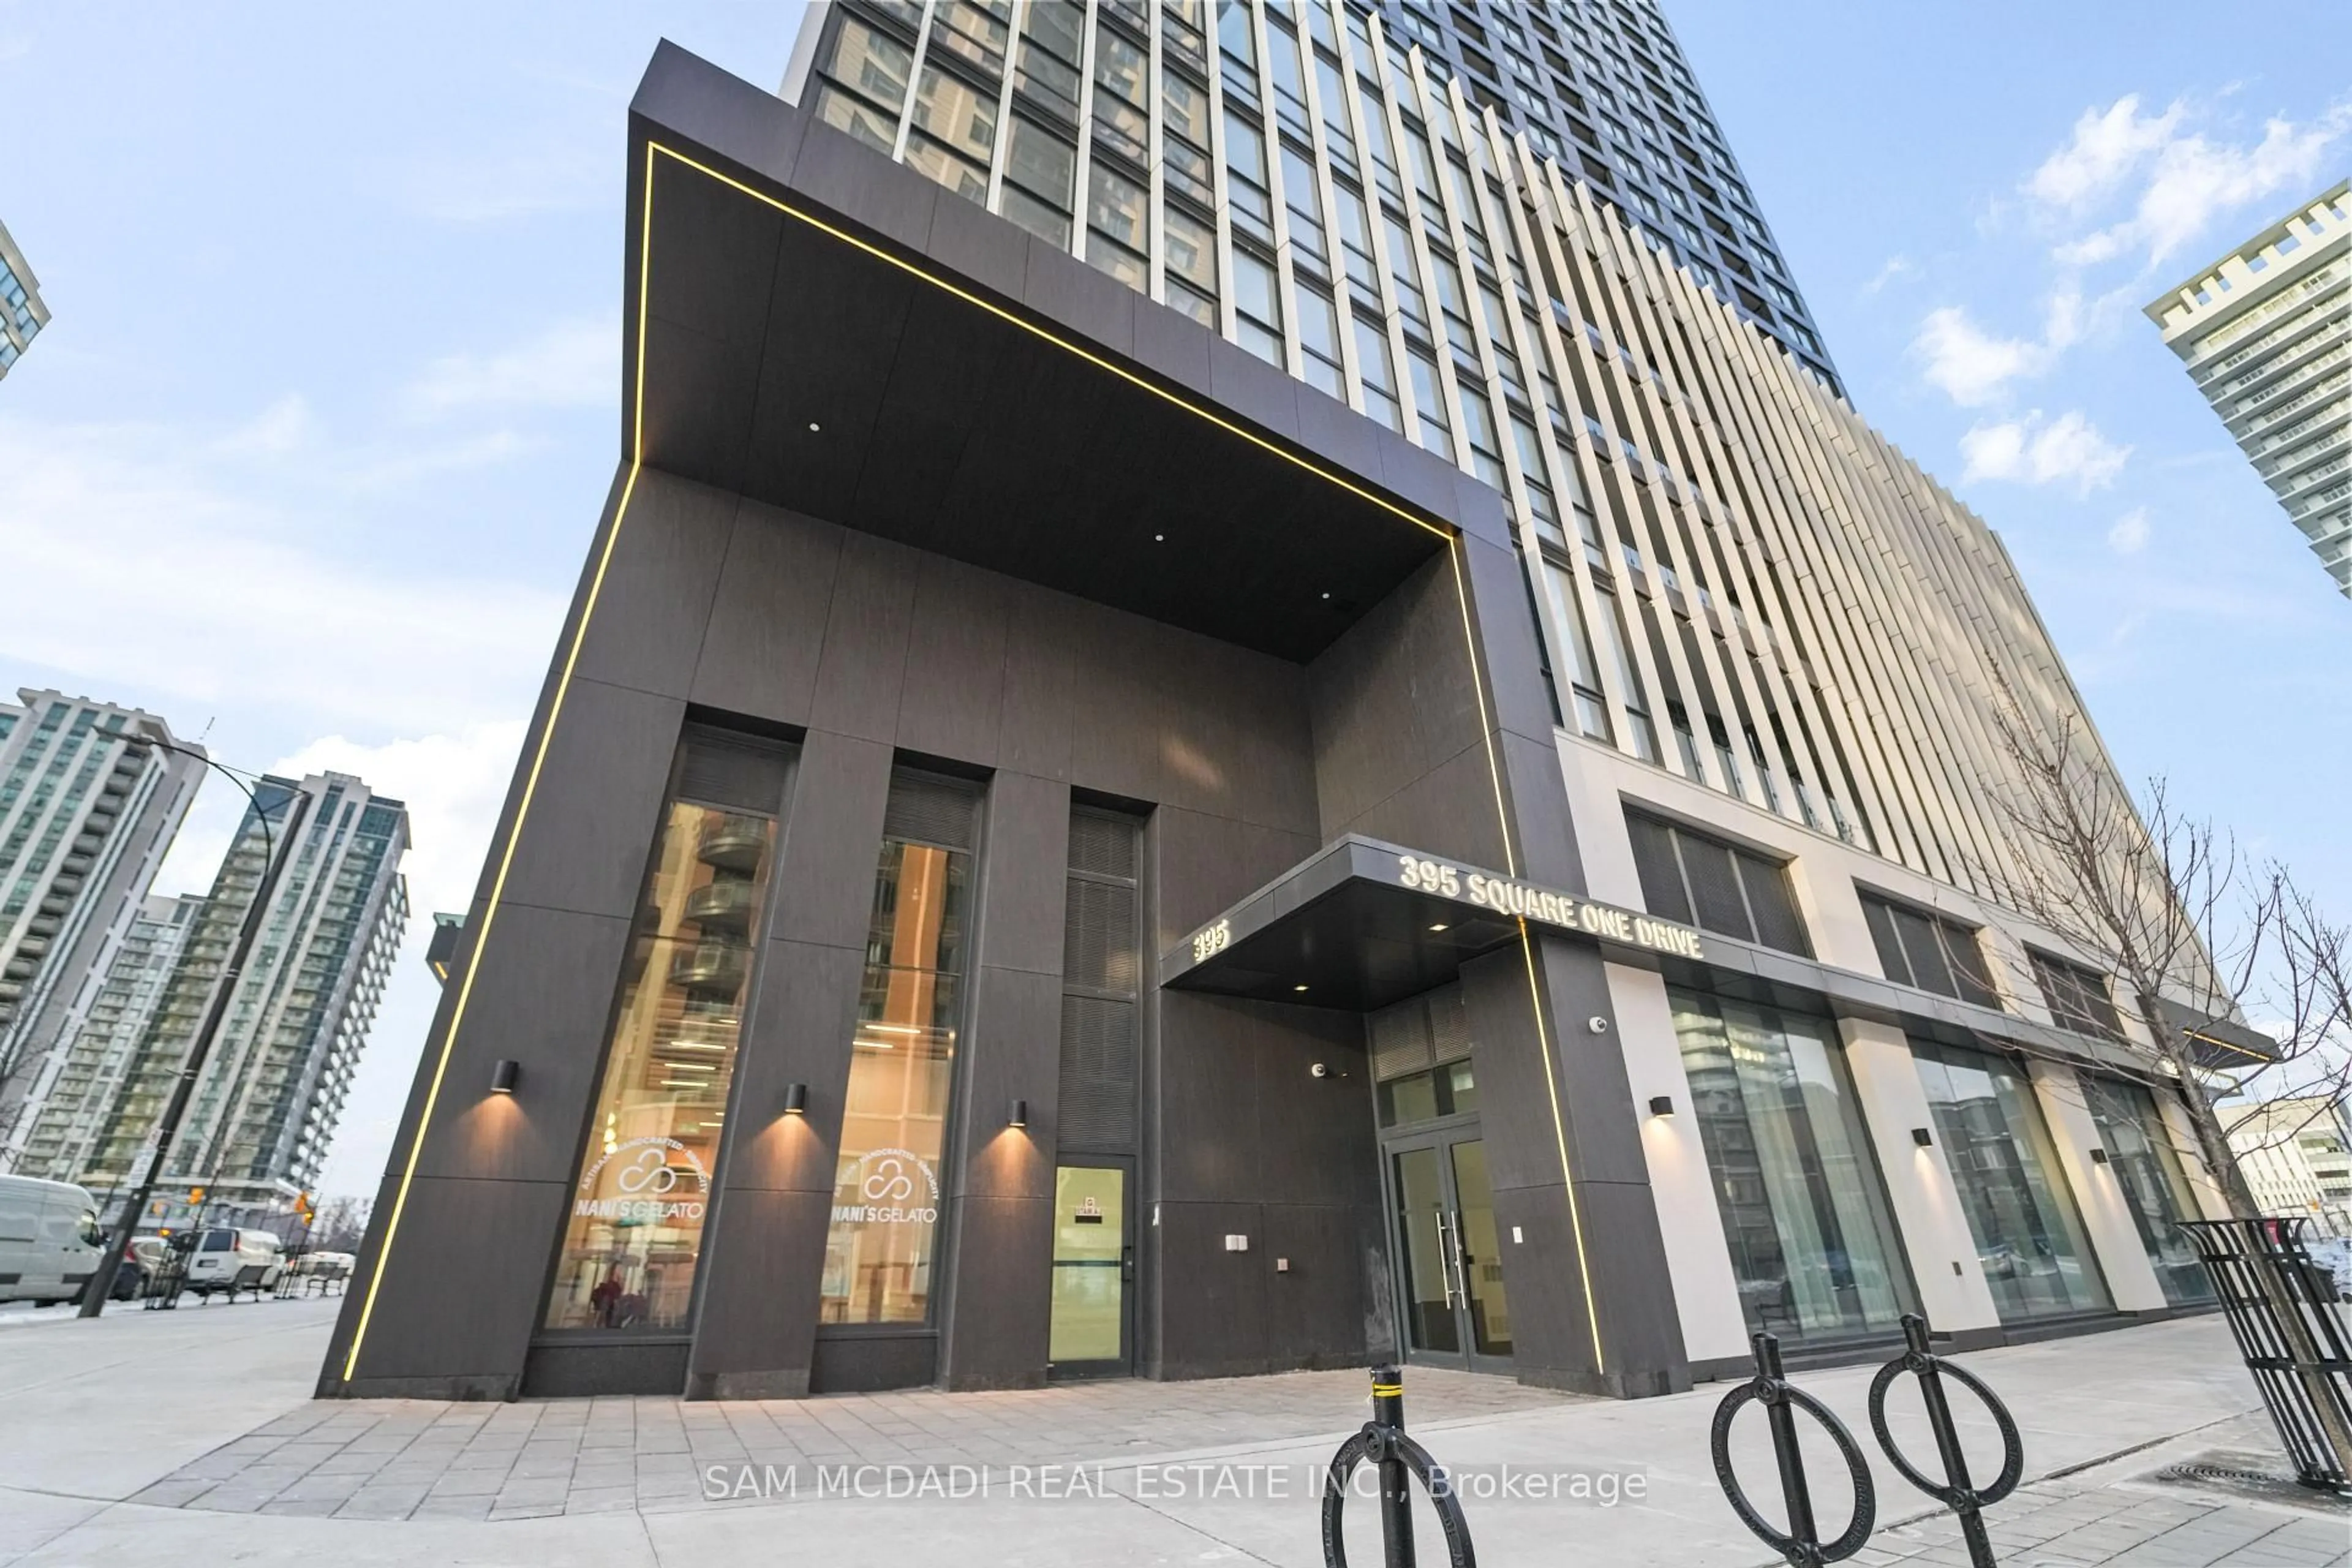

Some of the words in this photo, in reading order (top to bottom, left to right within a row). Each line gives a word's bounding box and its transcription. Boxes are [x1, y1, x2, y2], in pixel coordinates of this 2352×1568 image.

[1400, 855, 1461, 897] 395
[1468, 874, 1578, 927] SQUARE
[1580, 904, 1634, 941] ONE
[1634, 918, 1704, 959] DRIVE
[1193, 919, 1231, 962] 395
[877, 1207, 938, 1223] GELATO
